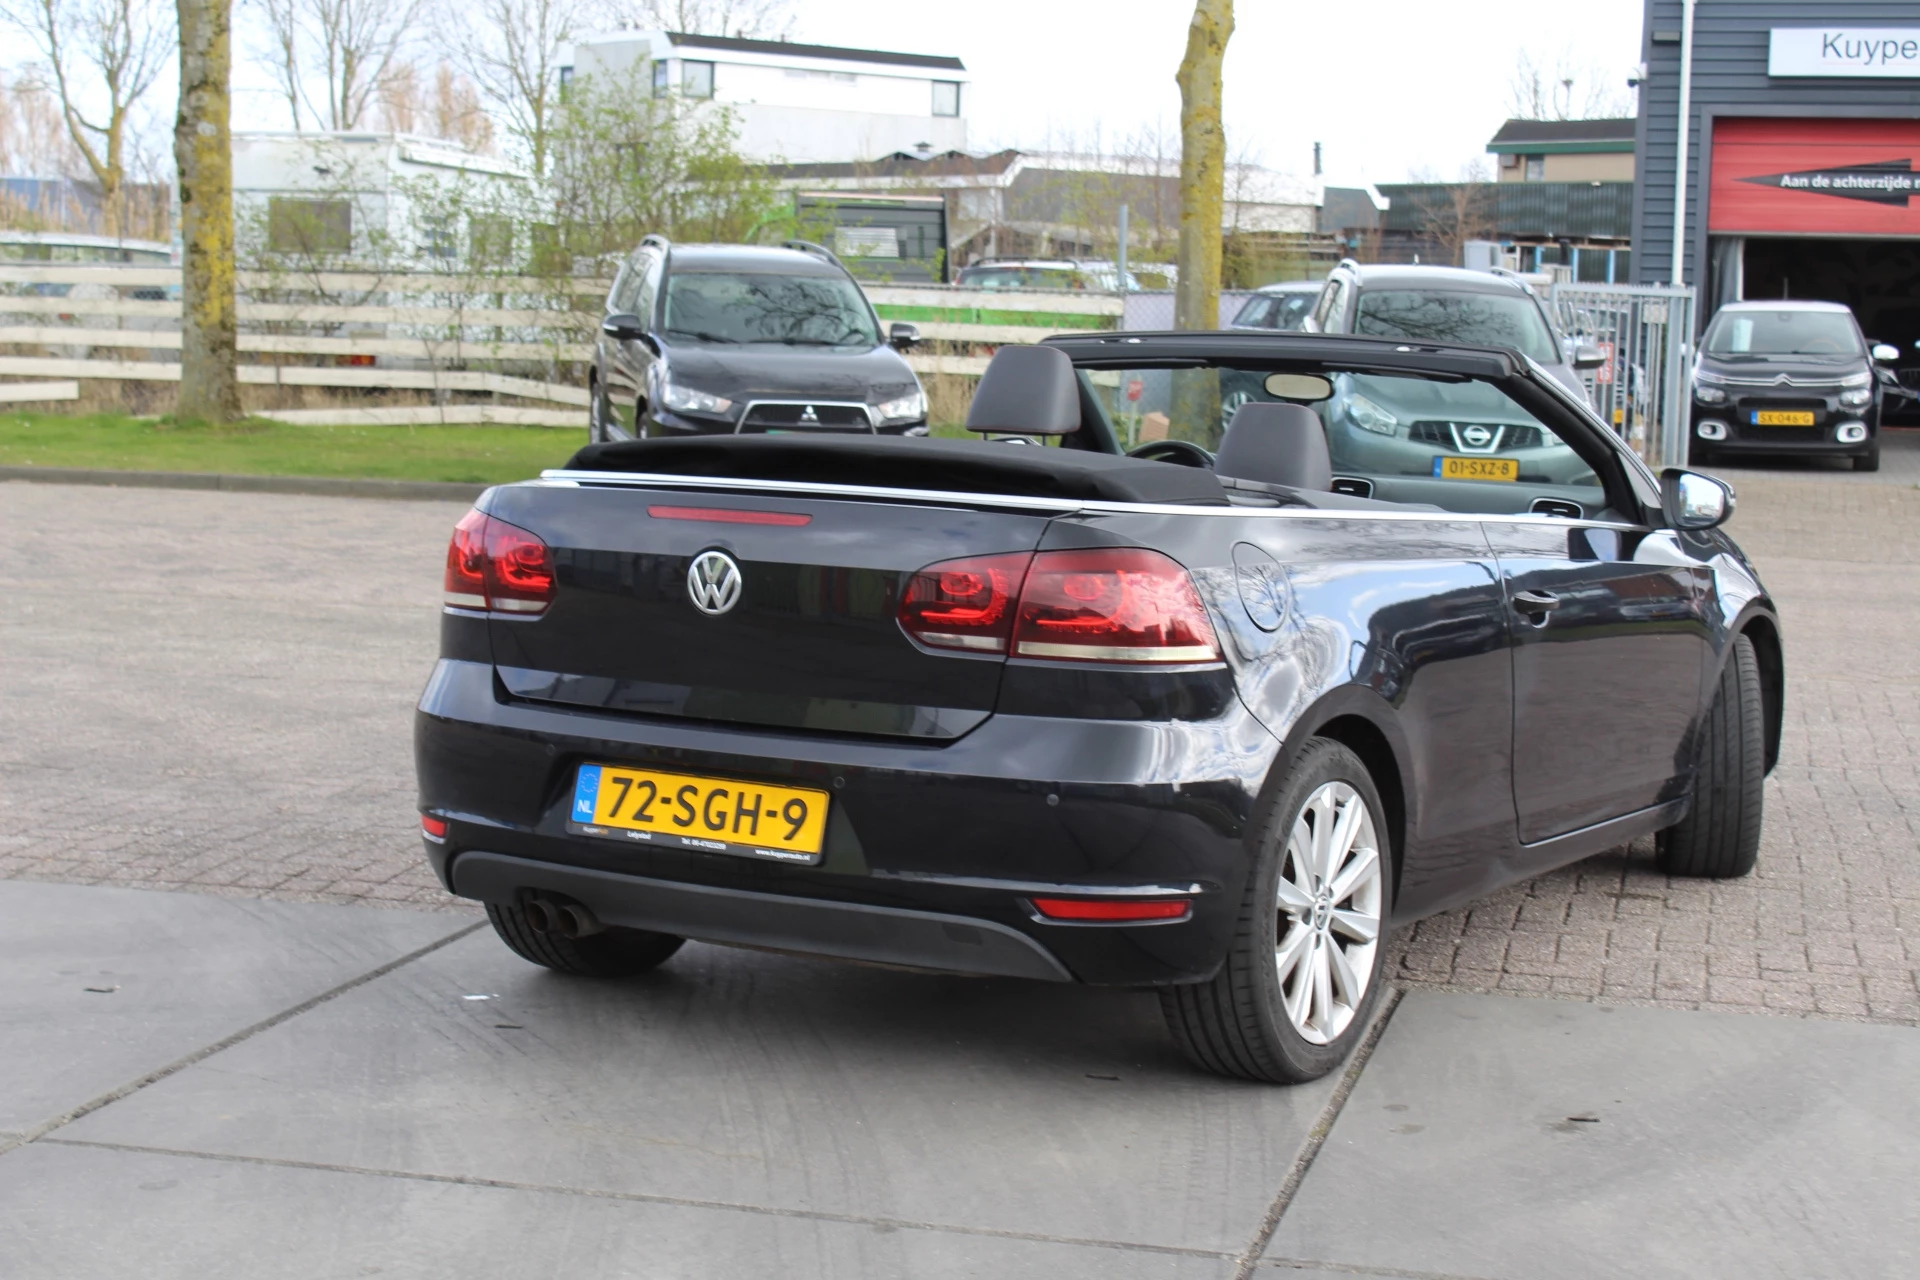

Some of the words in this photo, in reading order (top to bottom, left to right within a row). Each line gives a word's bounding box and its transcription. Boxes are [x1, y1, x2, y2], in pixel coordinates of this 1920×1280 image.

[1822, 33, 1919, 65] Kuype
[1780, 174, 1809, 188] Aan
[1811, 175, 1830, 188] de
[1832, 174, 1912, 192] achterzijde
[1449, 460, 1510, 476] 01-SXZ-8
[687, 551, 742, 615] VW
[577, 799, 593, 814] NL
[608, 776, 809, 841] 72-SGH-9
